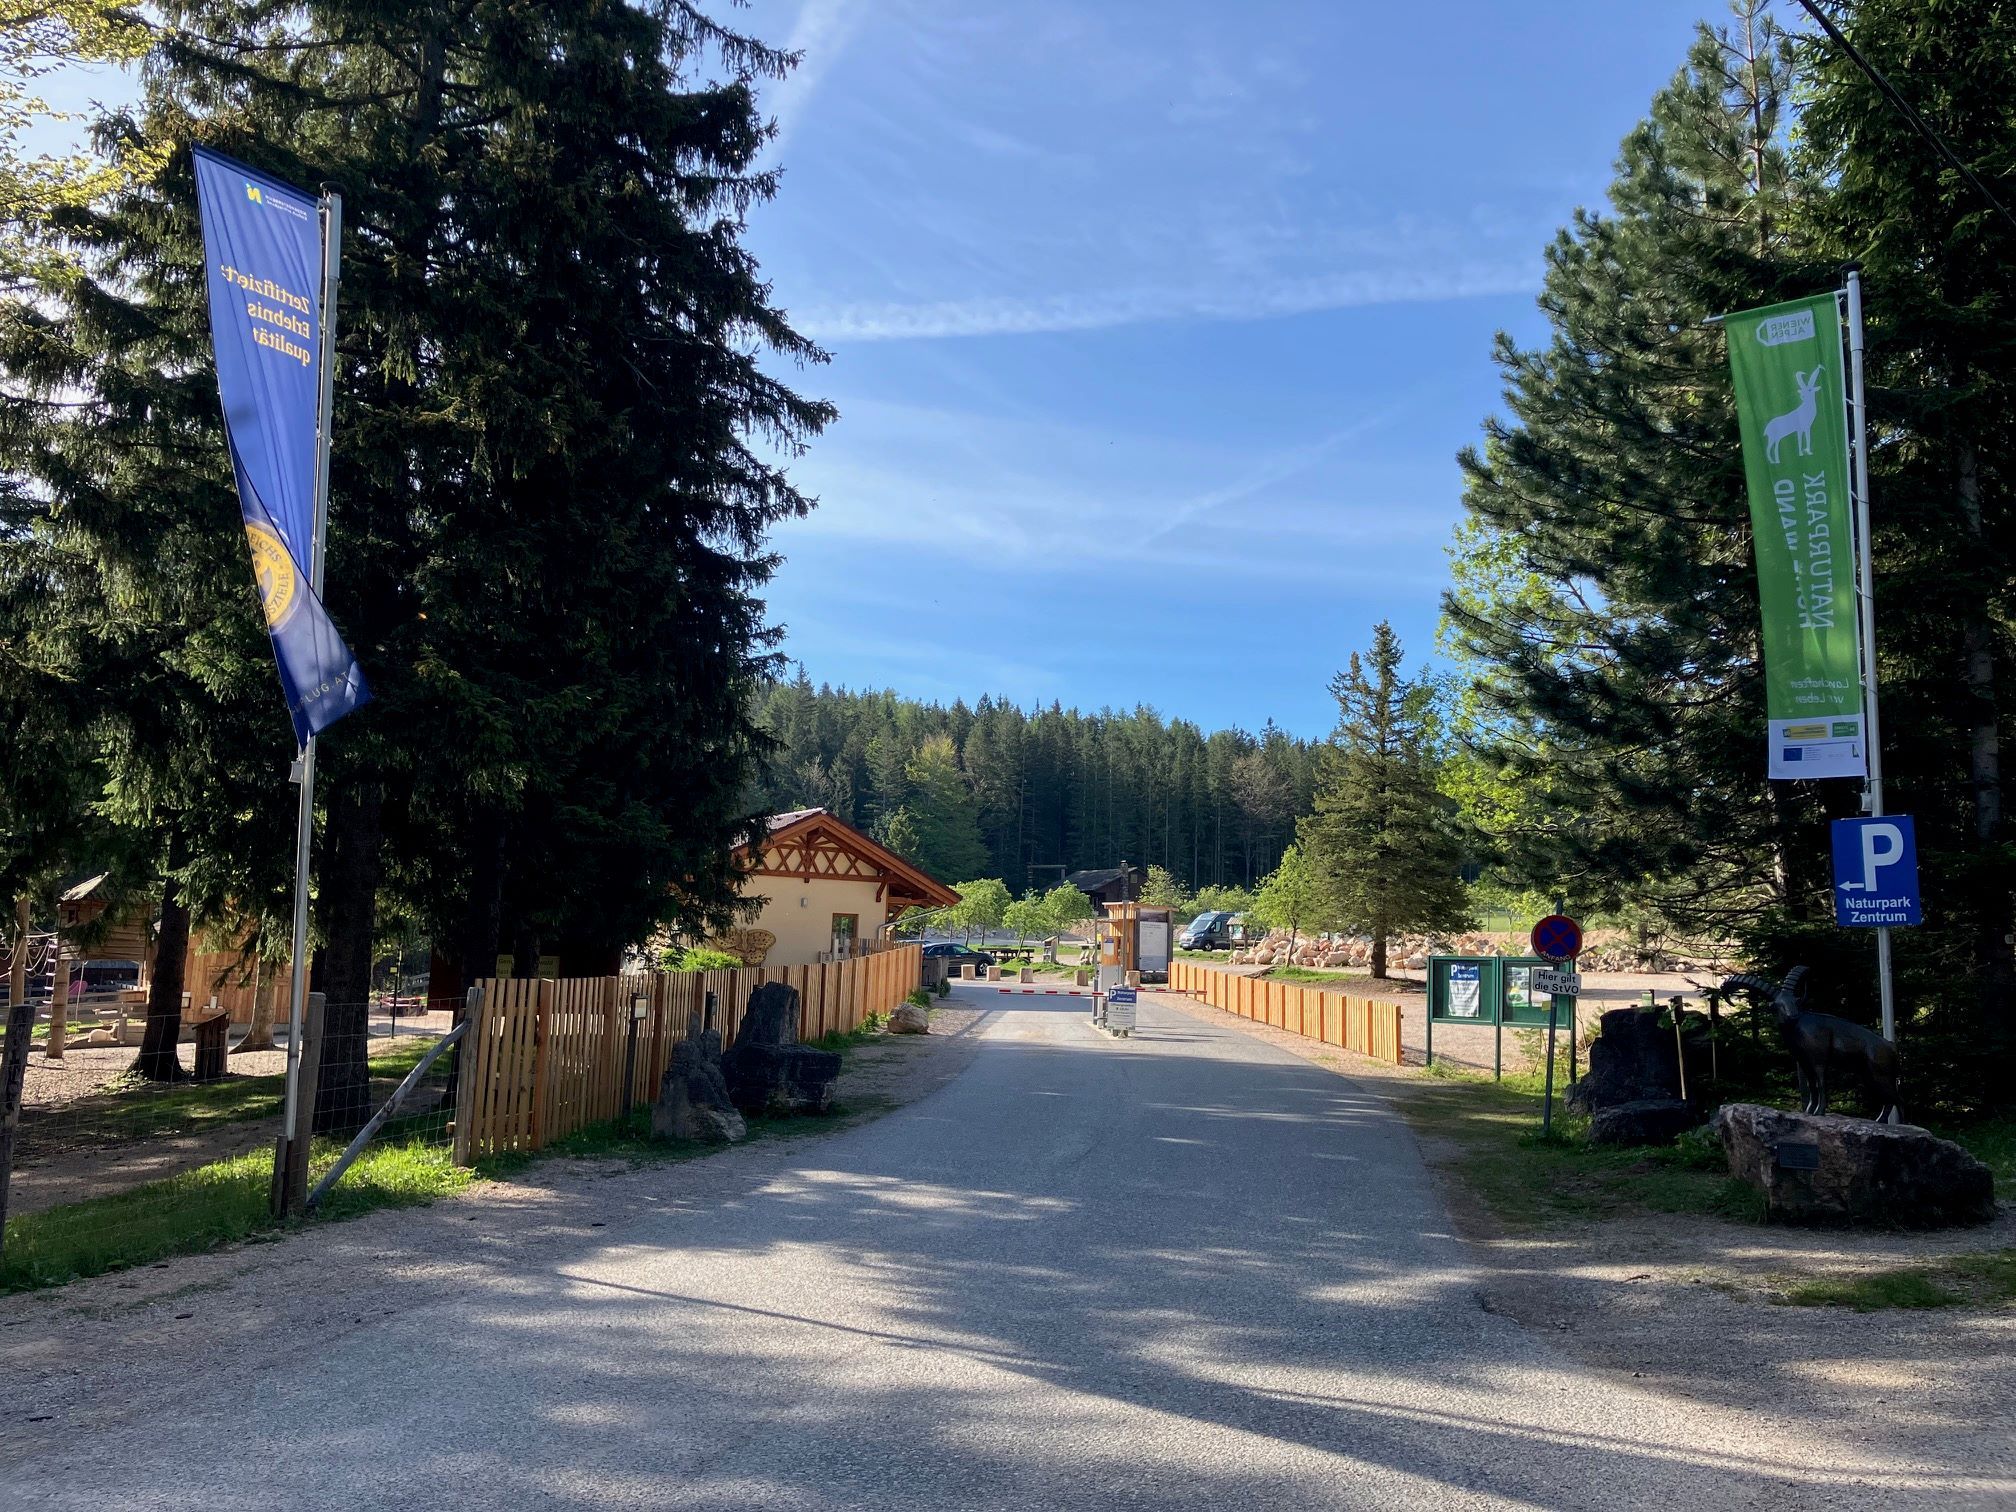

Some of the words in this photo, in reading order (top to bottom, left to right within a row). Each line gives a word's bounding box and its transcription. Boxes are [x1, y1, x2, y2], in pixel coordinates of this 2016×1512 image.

[1861, 823, 1904, 892] P
[1845, 896, 1911, 910] Naturpark
[1851, 911, 1907, 923] Zentrum
[1538, 971, 1558, 981] Hier
[1561, 974, 1576, 984] gilt
[1535, 981, 1549, 991] die
[1552, 983, 1579, 994] StVO
[1110, 989, 1117, 1000] P
